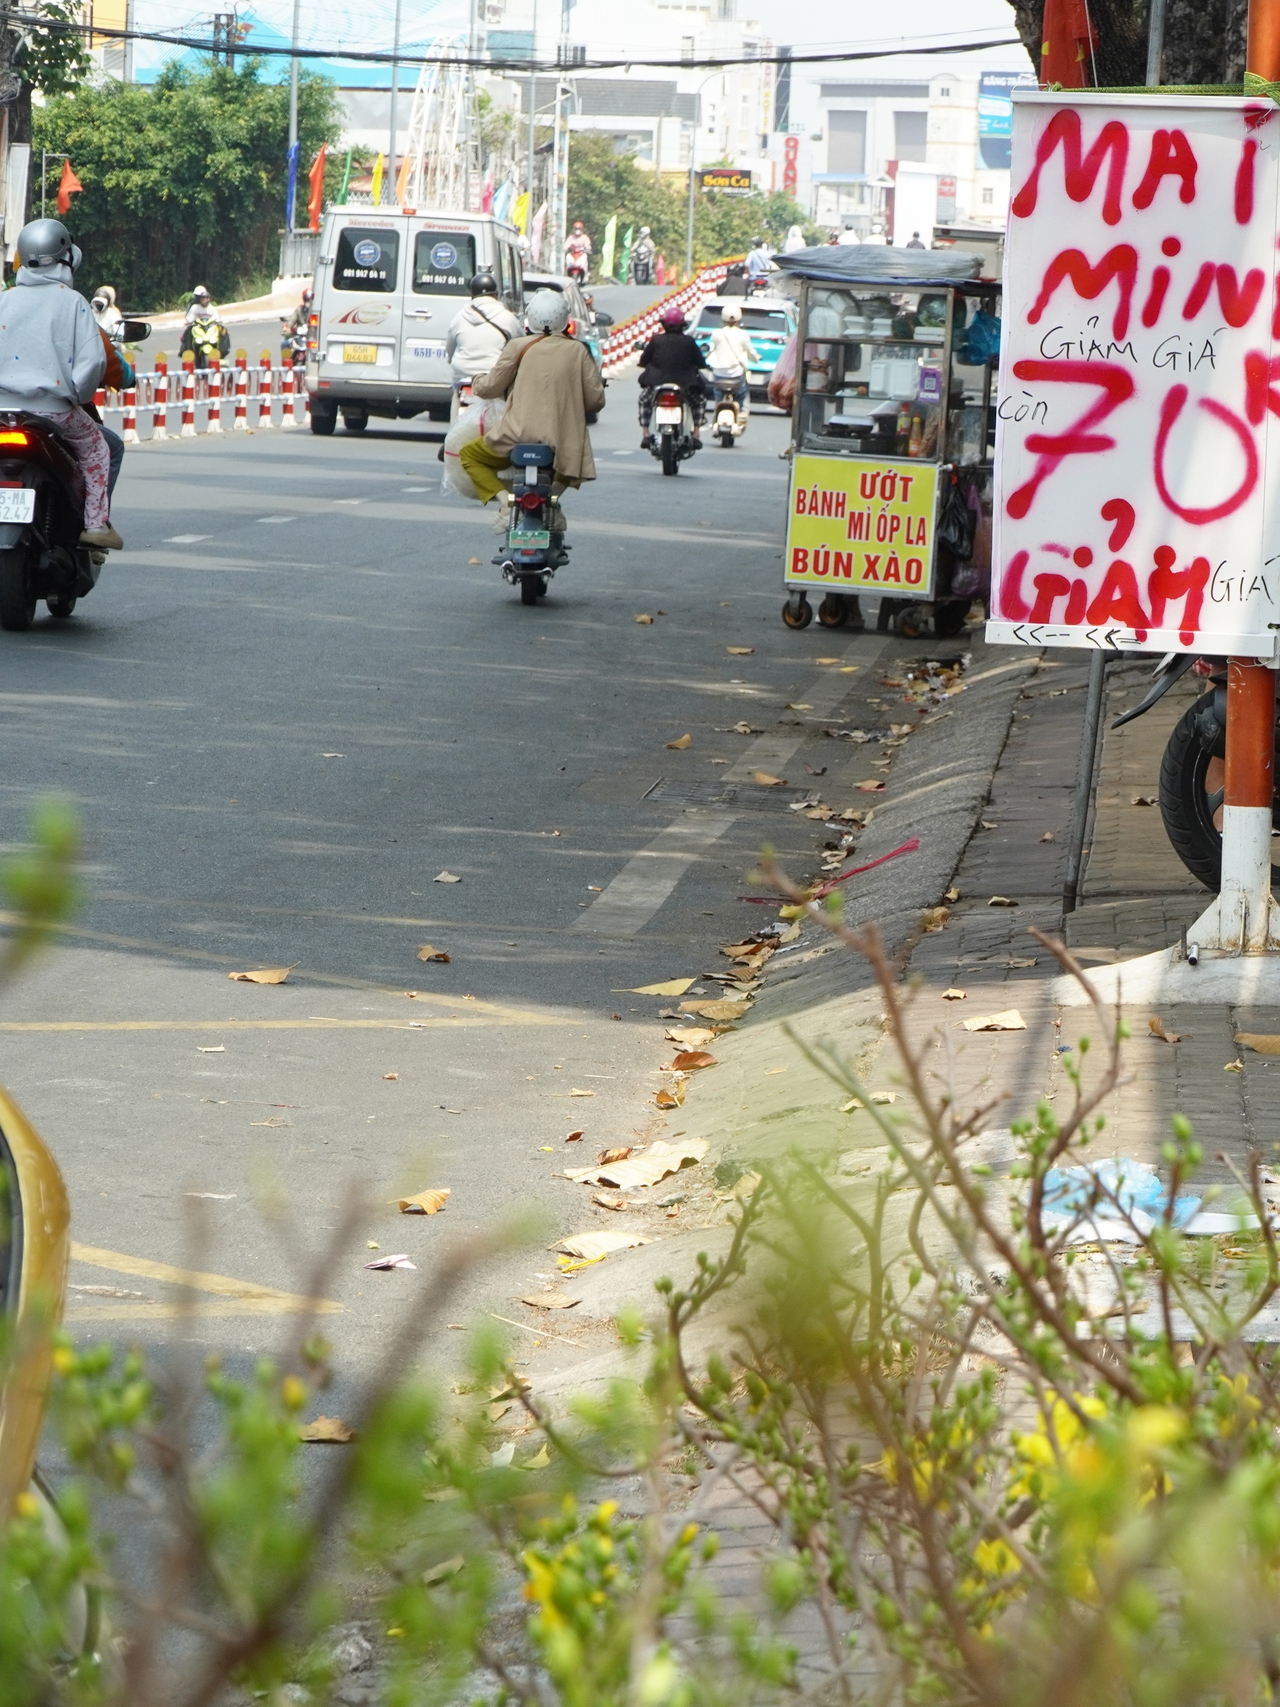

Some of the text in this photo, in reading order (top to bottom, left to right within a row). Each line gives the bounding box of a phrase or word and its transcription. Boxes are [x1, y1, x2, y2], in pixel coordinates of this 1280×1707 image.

[796, 484, 846, 518] BÁNH
[860, 469, 914, 503] ƯỚT
[0, 506, 30, 520] 2.47
[847, 503, 927, 546] MÌ ỐP LA
[792, 544, 923, 585] BÚN XÀO
